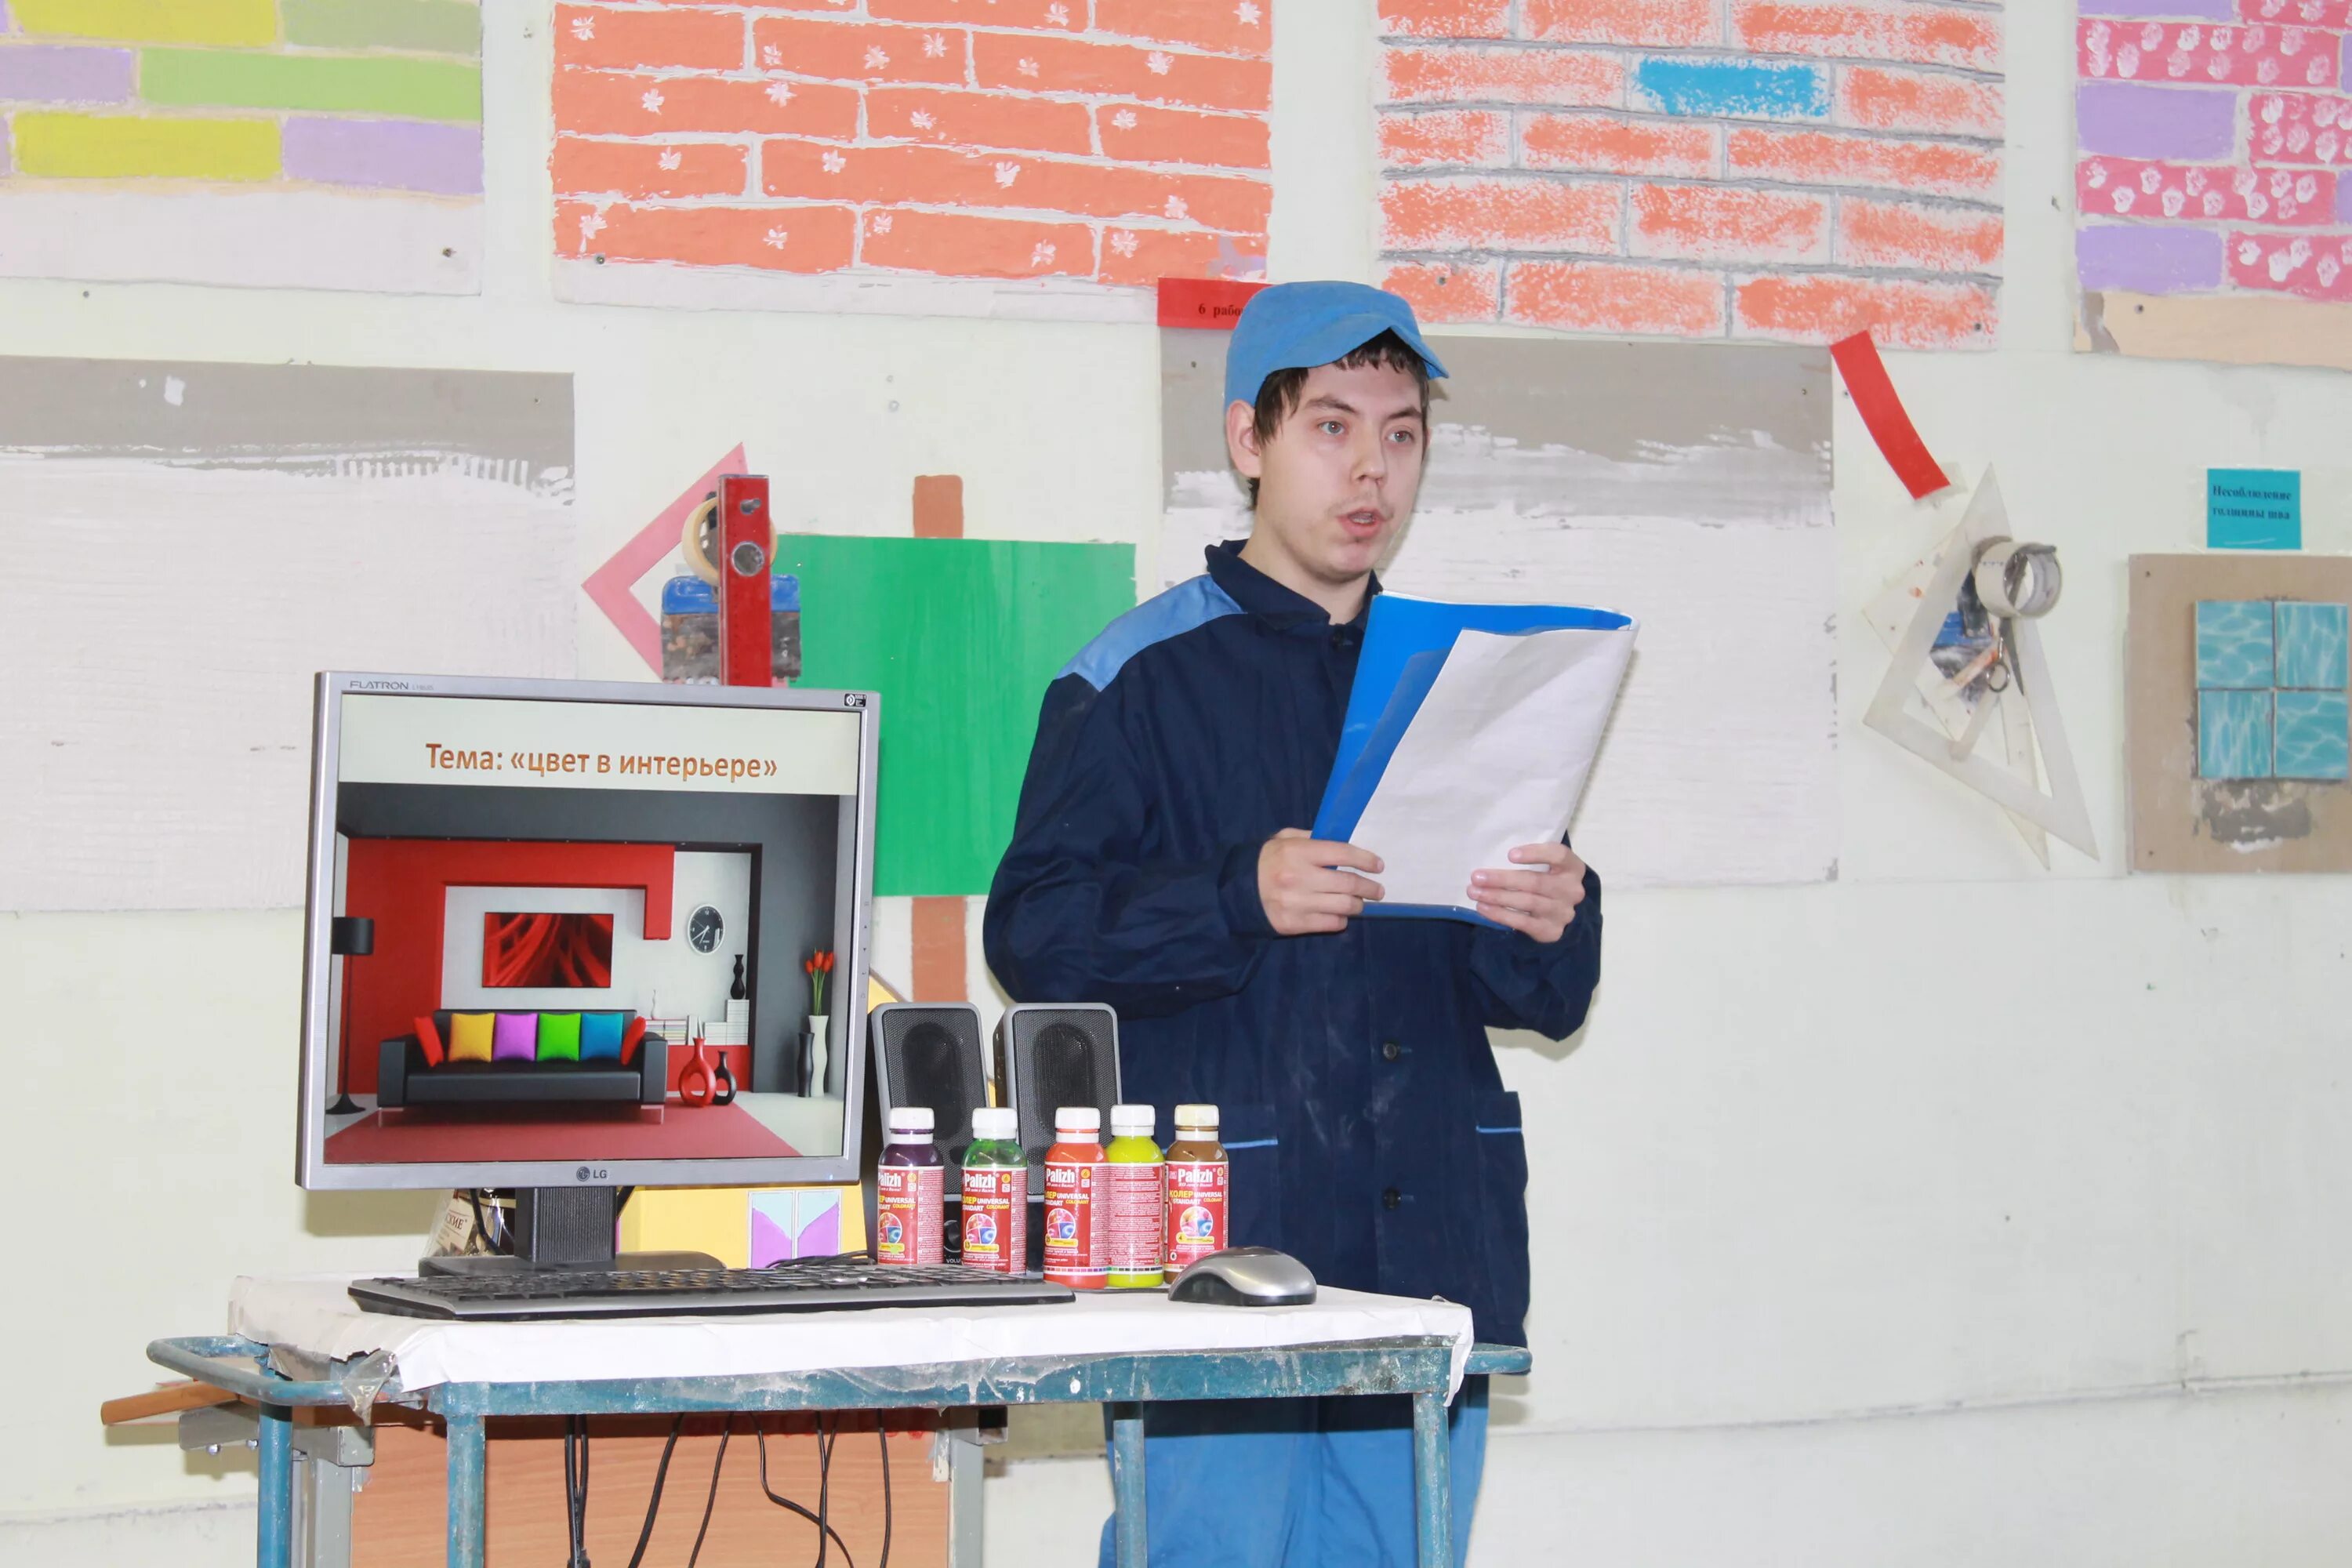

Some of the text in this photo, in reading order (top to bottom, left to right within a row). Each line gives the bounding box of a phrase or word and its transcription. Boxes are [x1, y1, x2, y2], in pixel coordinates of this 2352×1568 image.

[1198, 303, 1244, 318] 6 рабо
[2212, 485, 2292, 500] Несоблюдение
[2268, 510, 2290, 520] шва
[350, 681, 409, 690] FLATRON
[426, 743, 778, 783] Тема: «цвет в интерьере»
[593, 1170, 608, 1178] LG
[965, 1173, 996, 1189] Palizh
[1047, 1168, 1075, 1183] Palizh
[1178, 1168, 1213, 1183] Palizh
